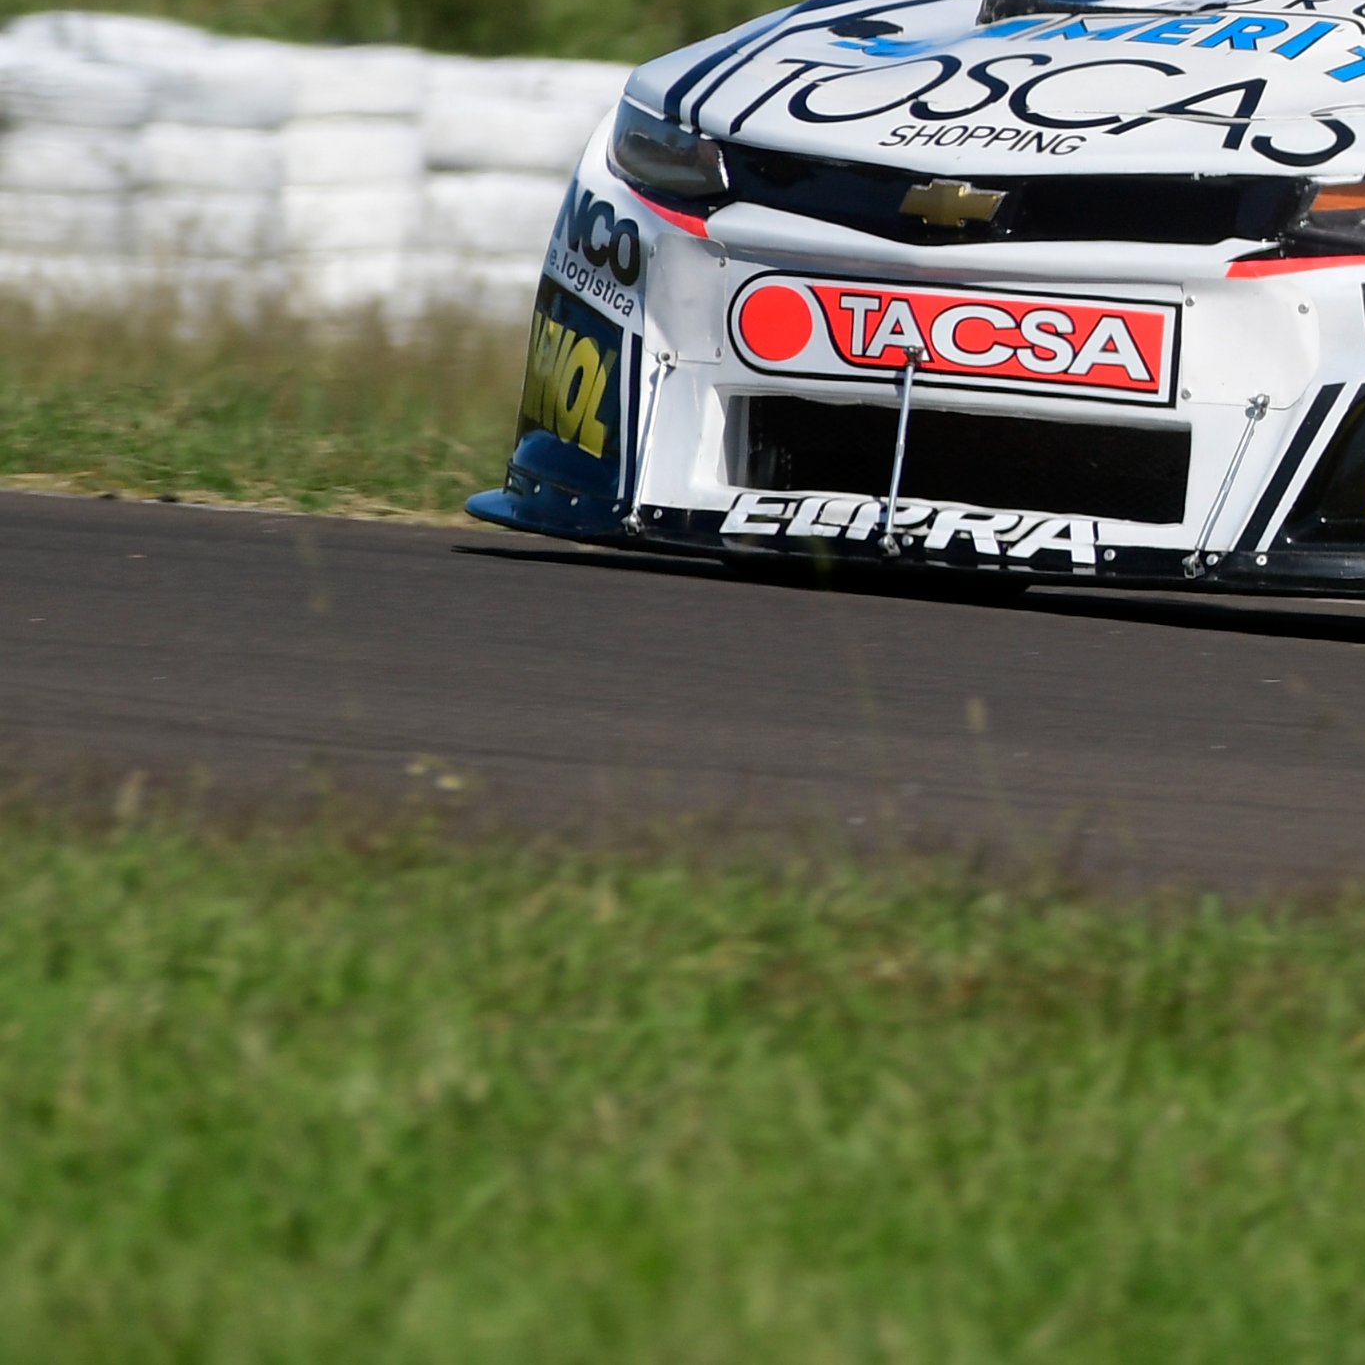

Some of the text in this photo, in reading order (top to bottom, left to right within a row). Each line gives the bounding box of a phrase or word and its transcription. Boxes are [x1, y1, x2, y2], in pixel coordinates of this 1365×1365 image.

[729, 51, 1356, 167] TOSCAS
[879, 123, 1088, 157] SHOPPING
[839, 294, 1153, 383] TACSA
